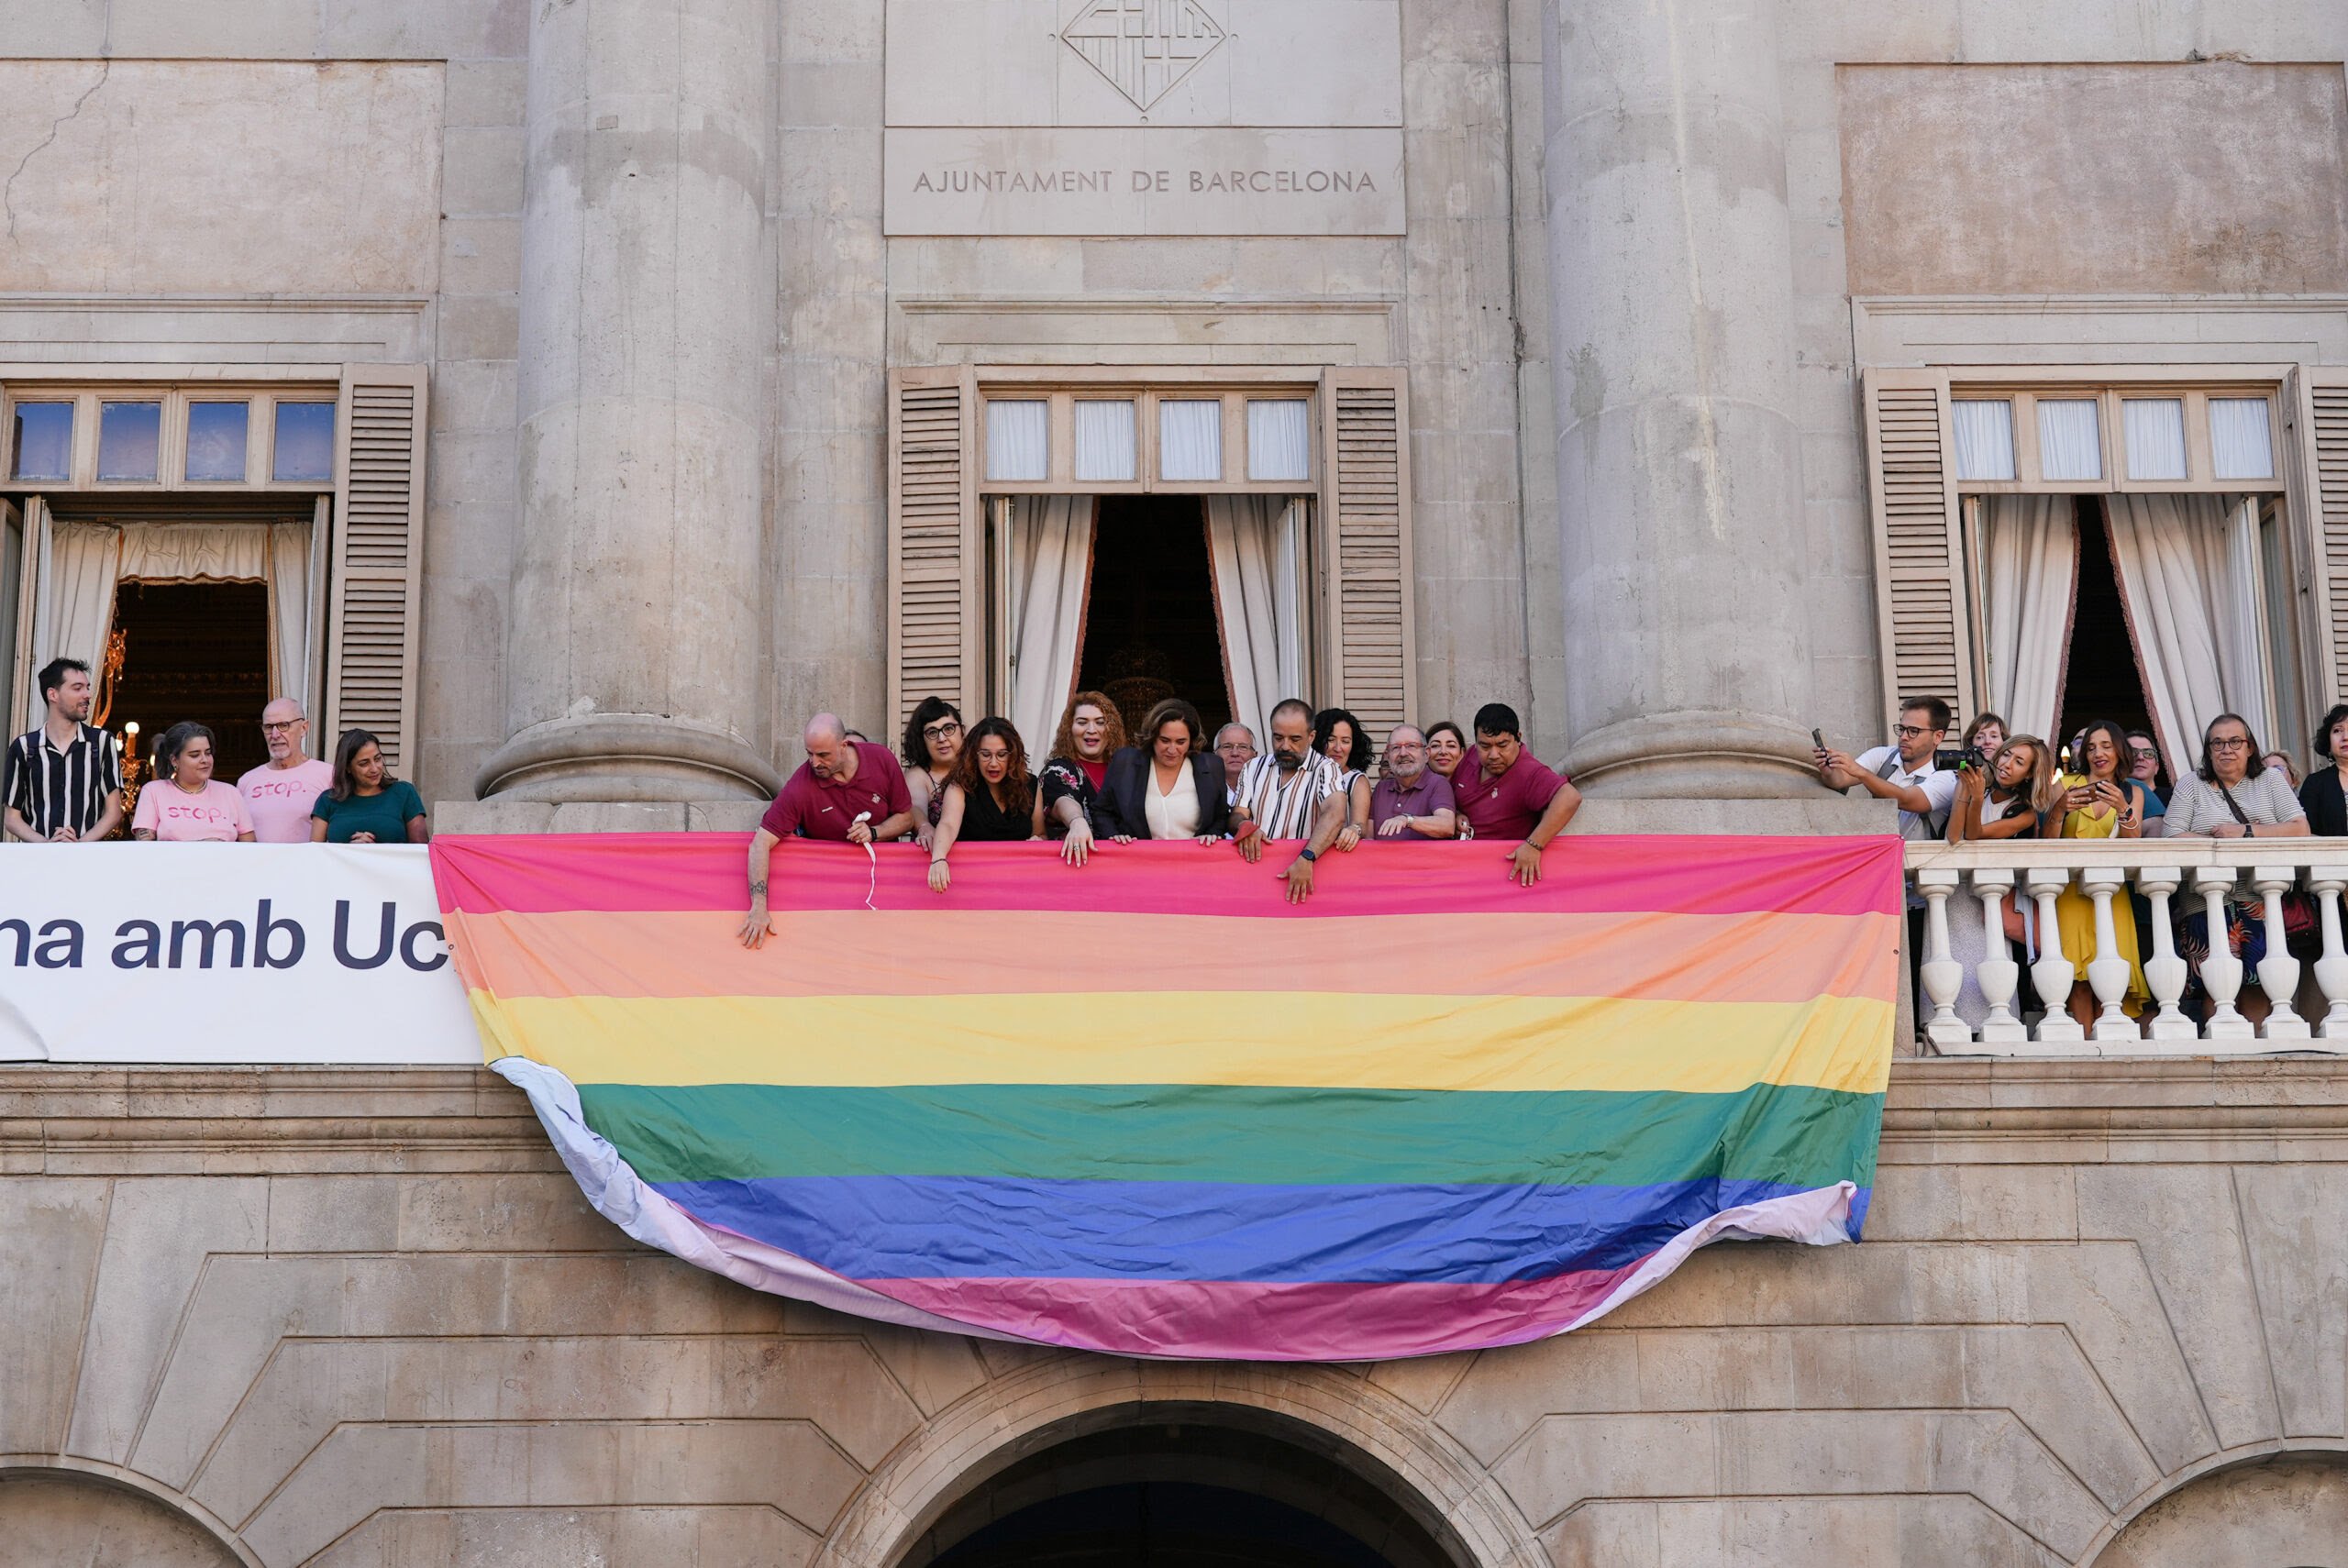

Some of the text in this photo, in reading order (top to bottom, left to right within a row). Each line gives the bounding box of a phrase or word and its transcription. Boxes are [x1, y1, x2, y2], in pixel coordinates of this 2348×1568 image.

[913, 170, 1378, 193] AJUNTAMENT DE BARCELONA
[111, 899, 306, 969] amb
